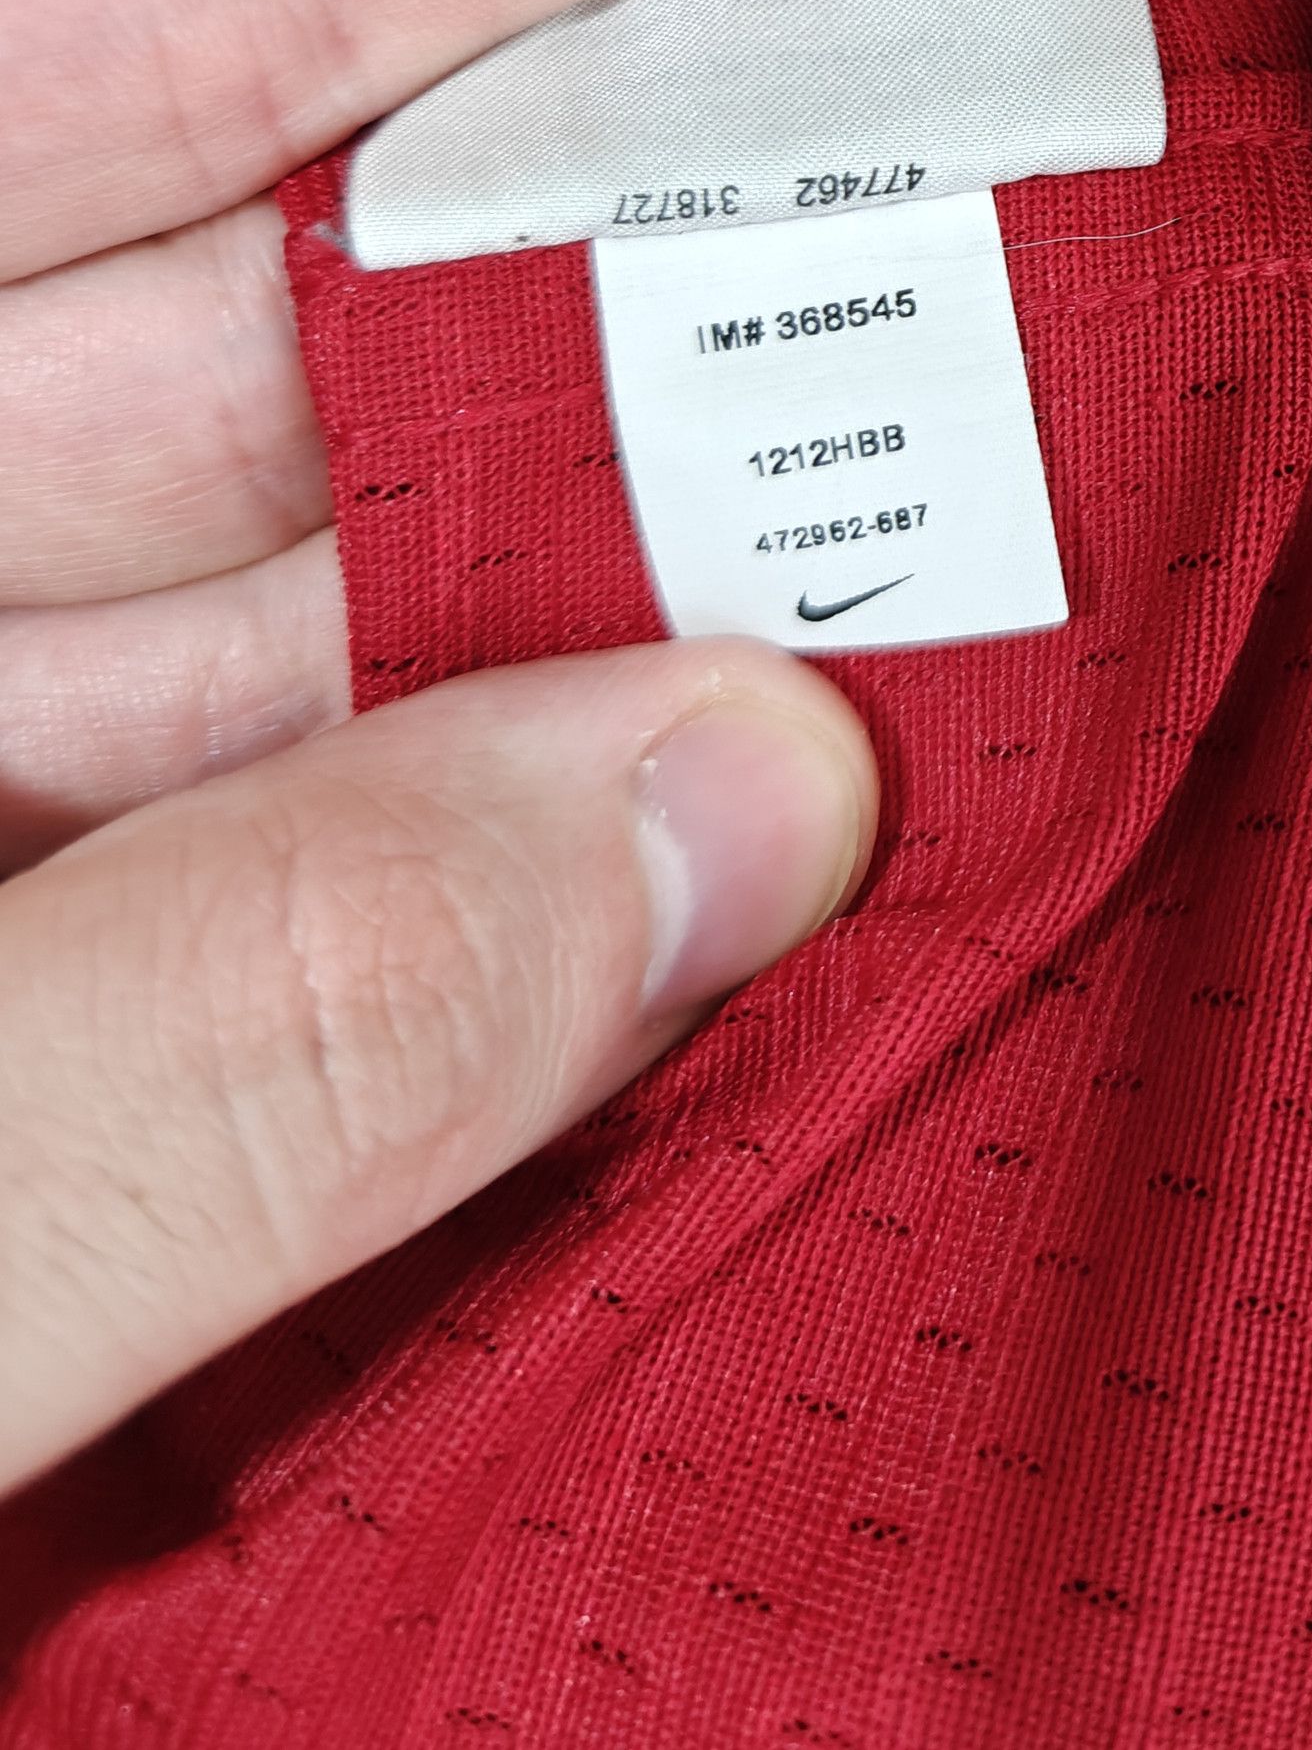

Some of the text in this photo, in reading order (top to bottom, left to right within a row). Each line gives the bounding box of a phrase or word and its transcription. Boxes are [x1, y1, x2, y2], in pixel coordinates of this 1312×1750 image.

[612, 163, 927, 225] 477462 318727
[697, 287, 918, 355] IM# 368545
[748, 423, 907, 478] 1212HBB
[756, 502, 929, 554] 472962-687
